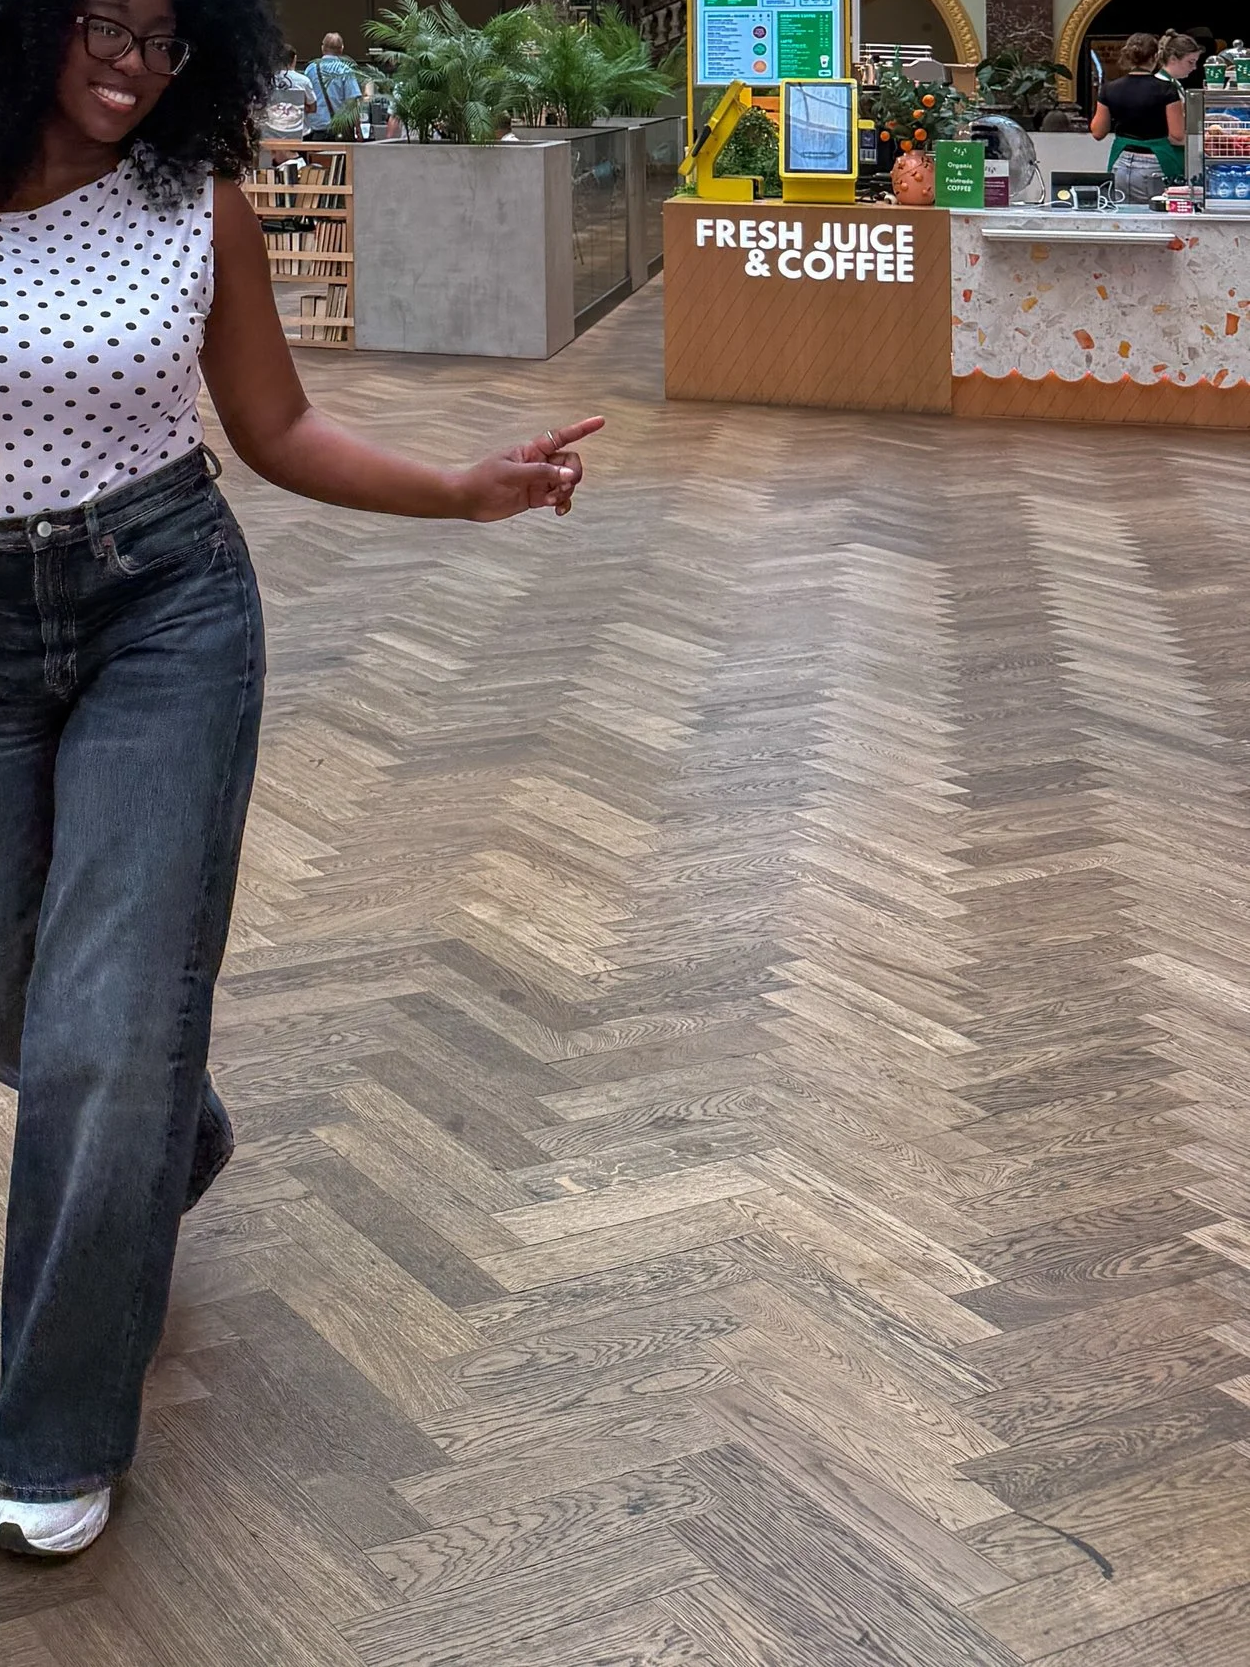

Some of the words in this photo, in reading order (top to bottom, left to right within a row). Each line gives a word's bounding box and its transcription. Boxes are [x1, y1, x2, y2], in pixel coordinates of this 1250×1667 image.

[947, 161, 973, 170] Organic
[945, 177, 974, 185] Fairtrade
[947, 184, 972, 192] COFFEE
[696, 218, 803, 249] FRESH
[813, 222, 914, 253] JUICE
[744, 249, 771, 277] &
[777, 249, 914, 282] COFFEE
